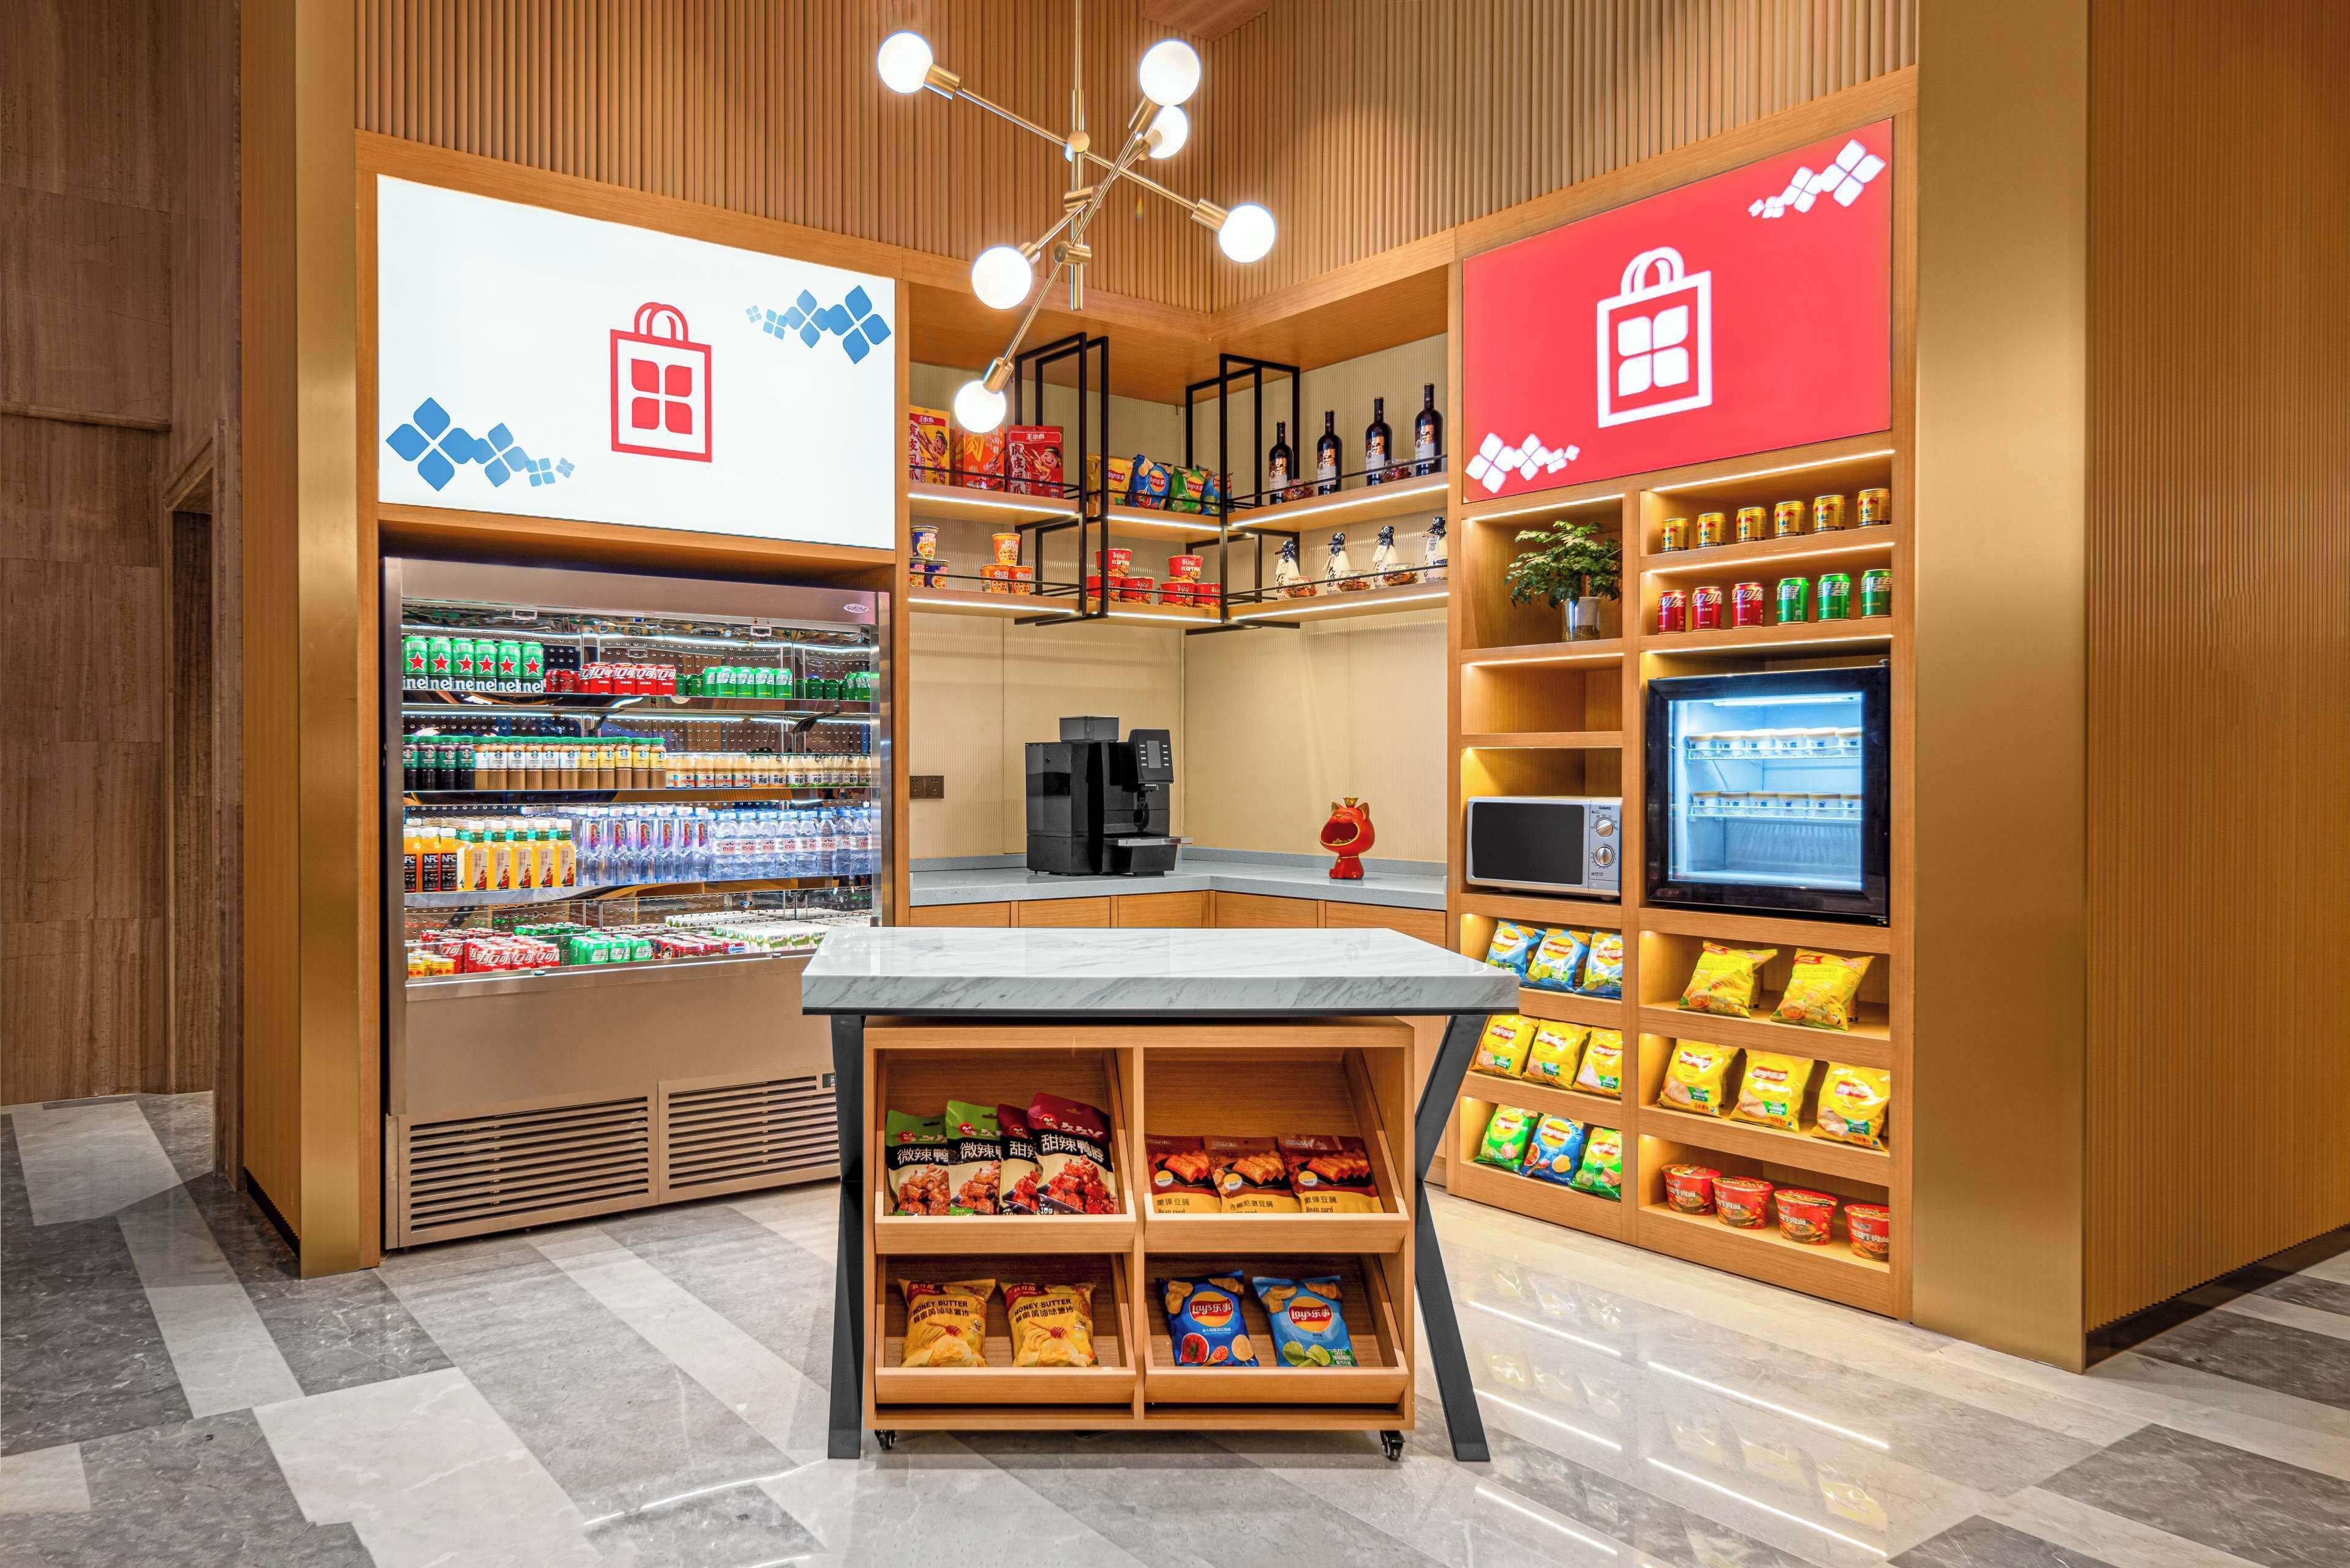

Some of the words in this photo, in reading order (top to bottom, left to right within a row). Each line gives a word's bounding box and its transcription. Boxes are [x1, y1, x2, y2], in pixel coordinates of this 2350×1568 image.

[897, 1147, 949, 1165] 微辣鸭
[1041, 1133, 1104, 1163] 甜辣鸭脖
[913, 1300, 936, 1314] HONEY
[1014, 1302, 1039, 1316] HONEY
[1041, 1298, 1072, 1308] BUTTER
